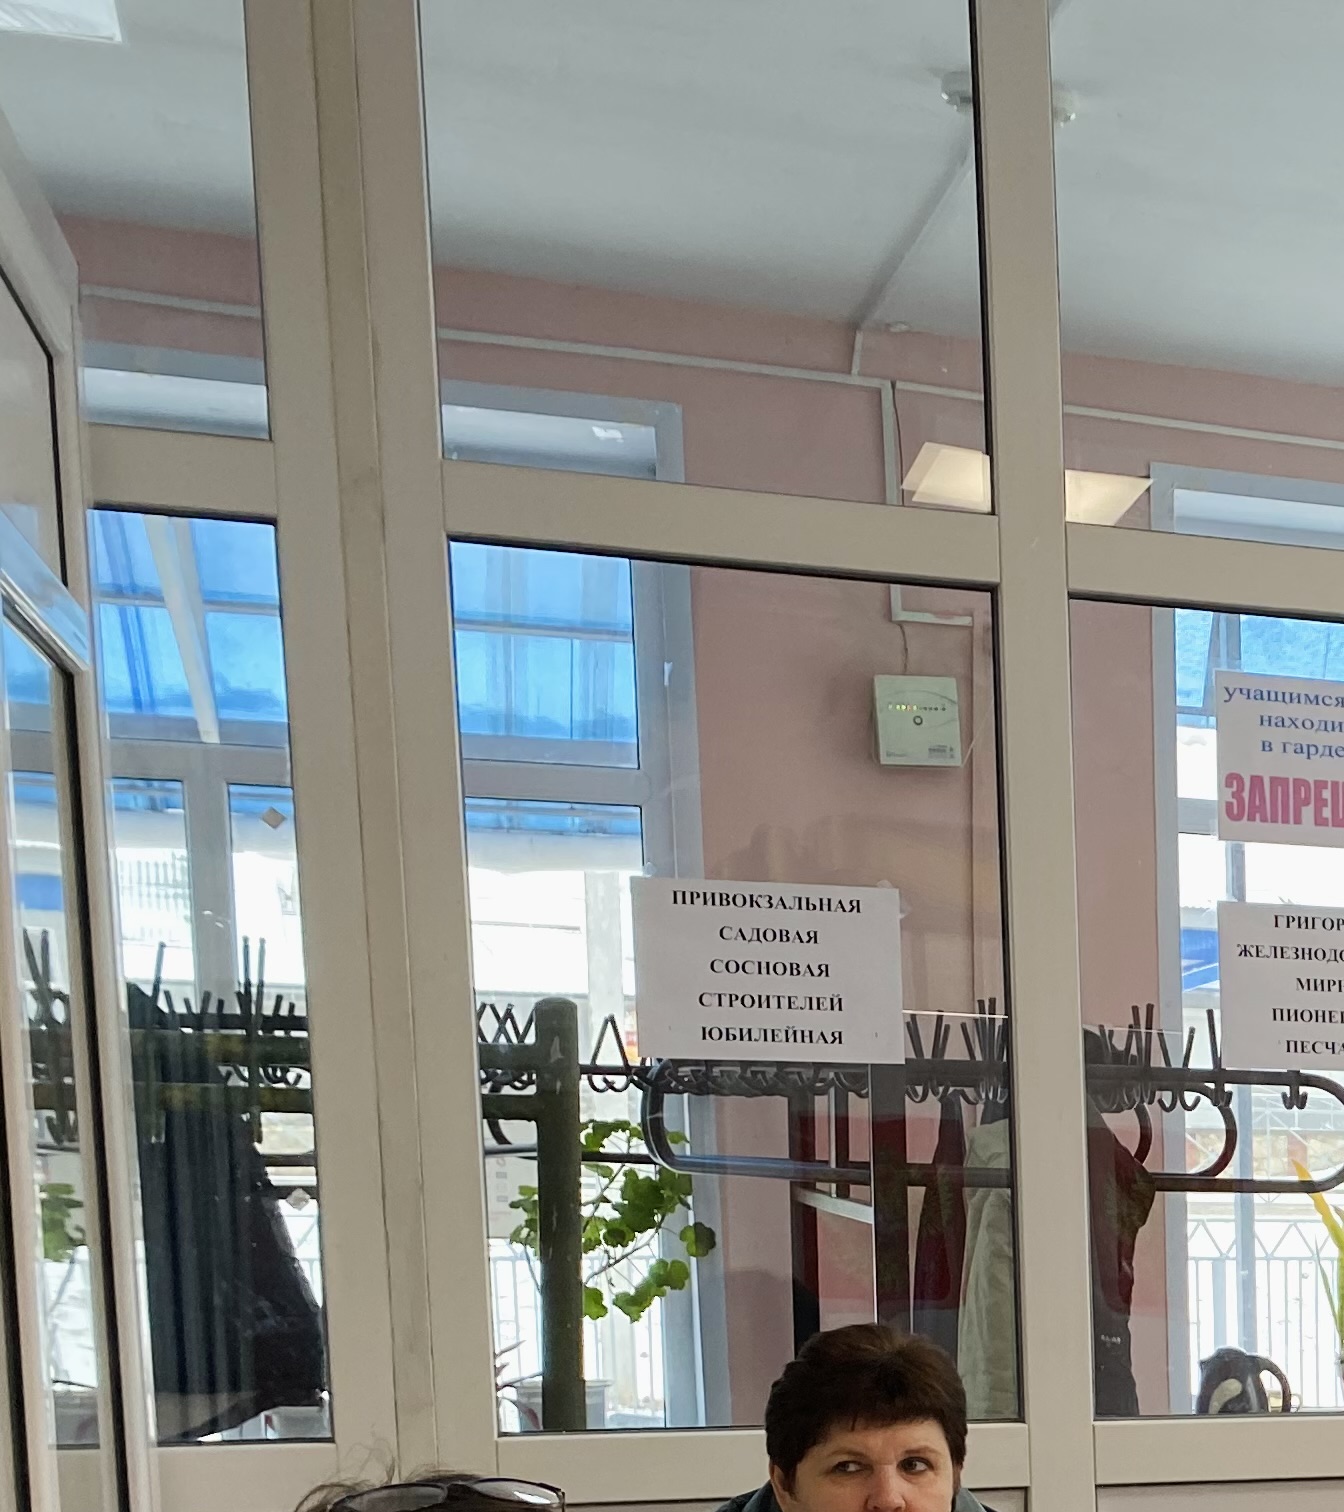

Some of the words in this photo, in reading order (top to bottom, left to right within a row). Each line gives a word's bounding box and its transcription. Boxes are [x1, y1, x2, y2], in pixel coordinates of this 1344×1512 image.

[1223, 686, 1344, 709] учащимся
[1261, 740, 1273, 752] в
[672, 890, 861, 914] ПРИВОКЗАЛЬНАЯ
[719, 925, 819, 944] САДОВАЯ
[710, 958, 830, 978] СОСНОВАЯ
[698, 991, 843, 1012] СТРОИТЕЛЕЙ
[701, 1025, 843, 1045] ЮБИЛЕЙНАЯ
